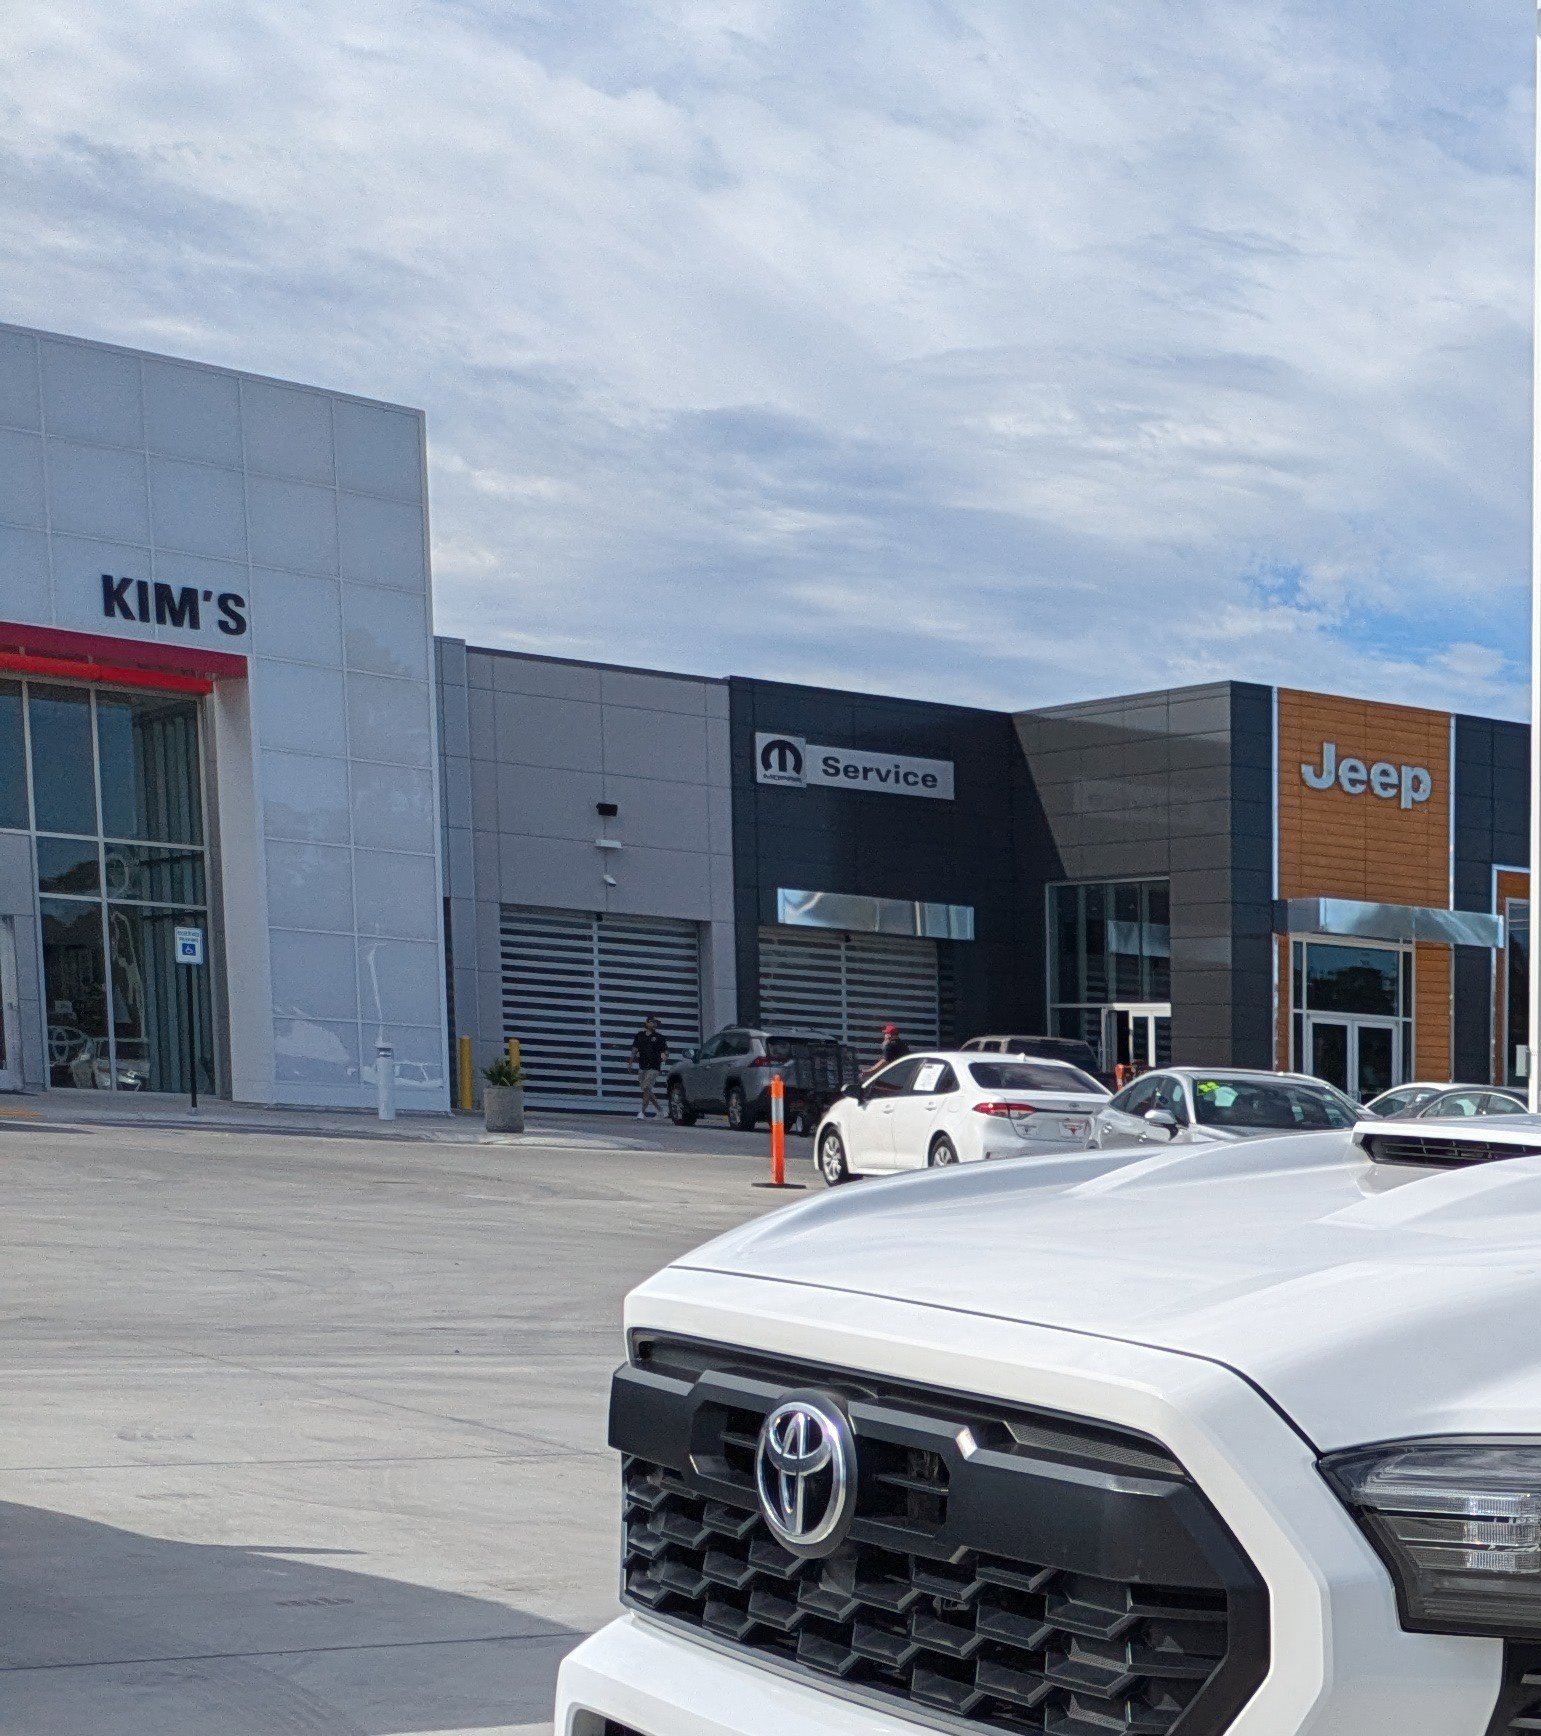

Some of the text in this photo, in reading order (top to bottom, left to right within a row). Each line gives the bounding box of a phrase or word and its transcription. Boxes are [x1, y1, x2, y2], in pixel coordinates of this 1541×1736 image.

[101, 574, 247, 636] KIM'S
[822, 756, 938, 789] Service
[1301, 741, 1432, 810] Jeep
